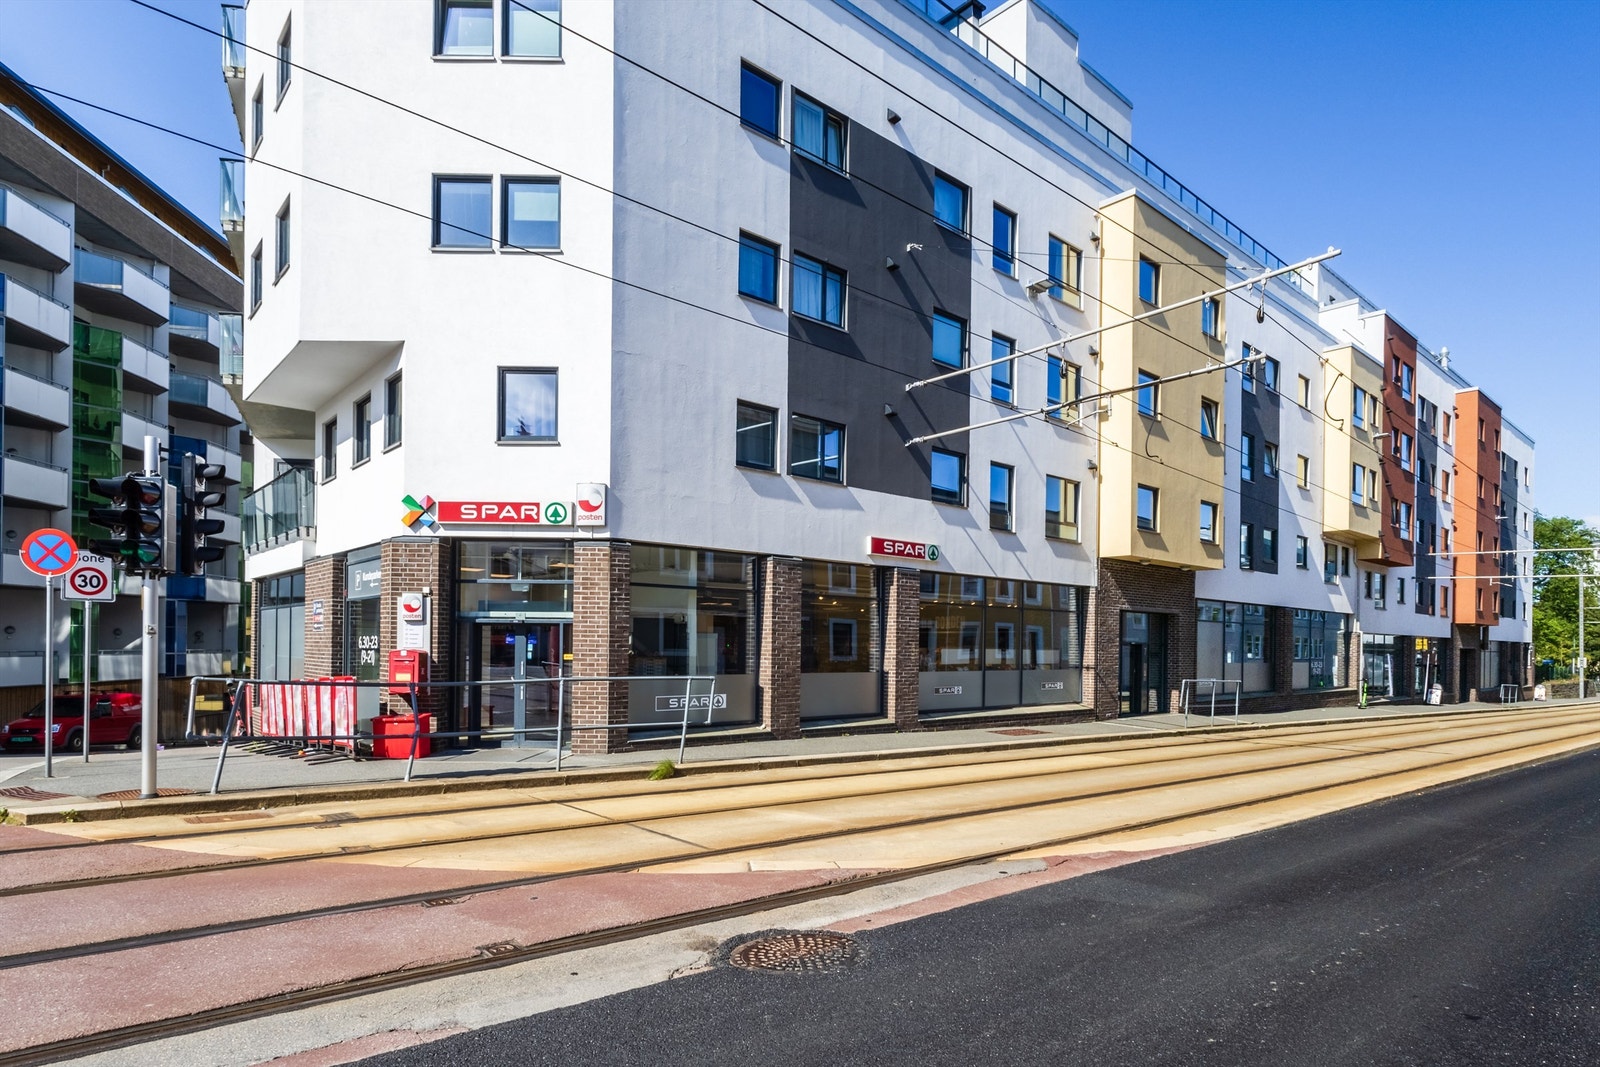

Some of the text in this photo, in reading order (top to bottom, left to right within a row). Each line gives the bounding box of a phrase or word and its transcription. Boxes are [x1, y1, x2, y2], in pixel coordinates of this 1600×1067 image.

[460, 504, 538, 520] SPAR
[883, 541, 925, 557] SPAR
[77, 574, 101, 588] 30
[358, 635, 378, 649] 6.30-23
